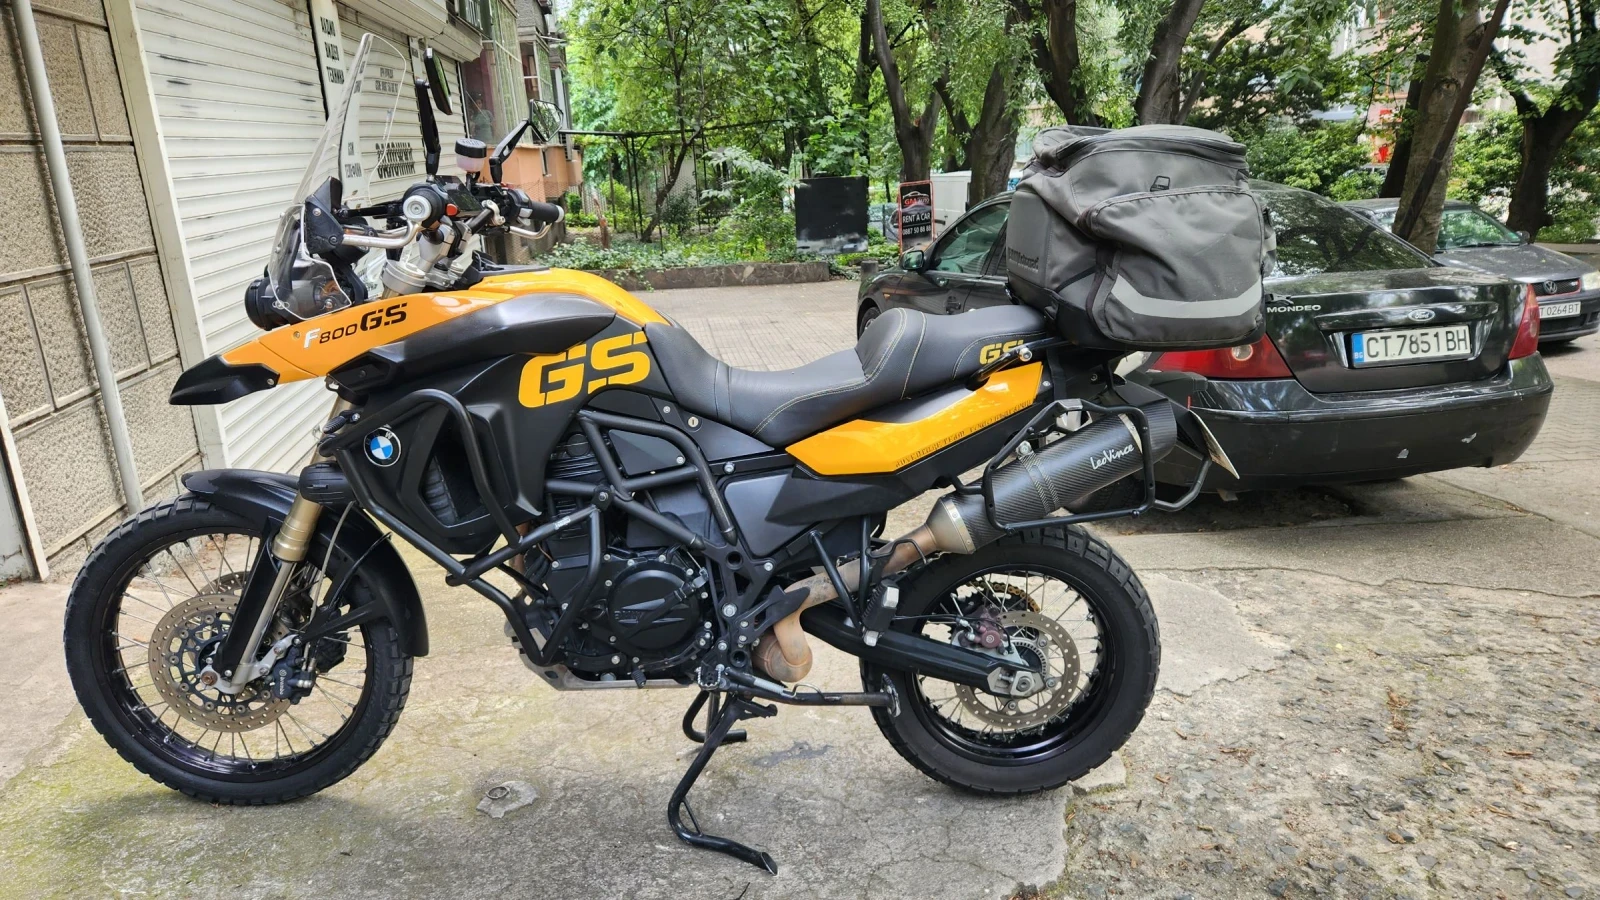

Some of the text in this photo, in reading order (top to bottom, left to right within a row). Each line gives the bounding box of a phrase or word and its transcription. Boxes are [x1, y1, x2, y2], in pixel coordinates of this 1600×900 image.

[902, 212, 931, 223] RENT A CAR
[1266, 304, 1322, 313] MONDEO
[517, 331, 651, 408] GS
[1090, 444, 1134, 470] LeoVince
